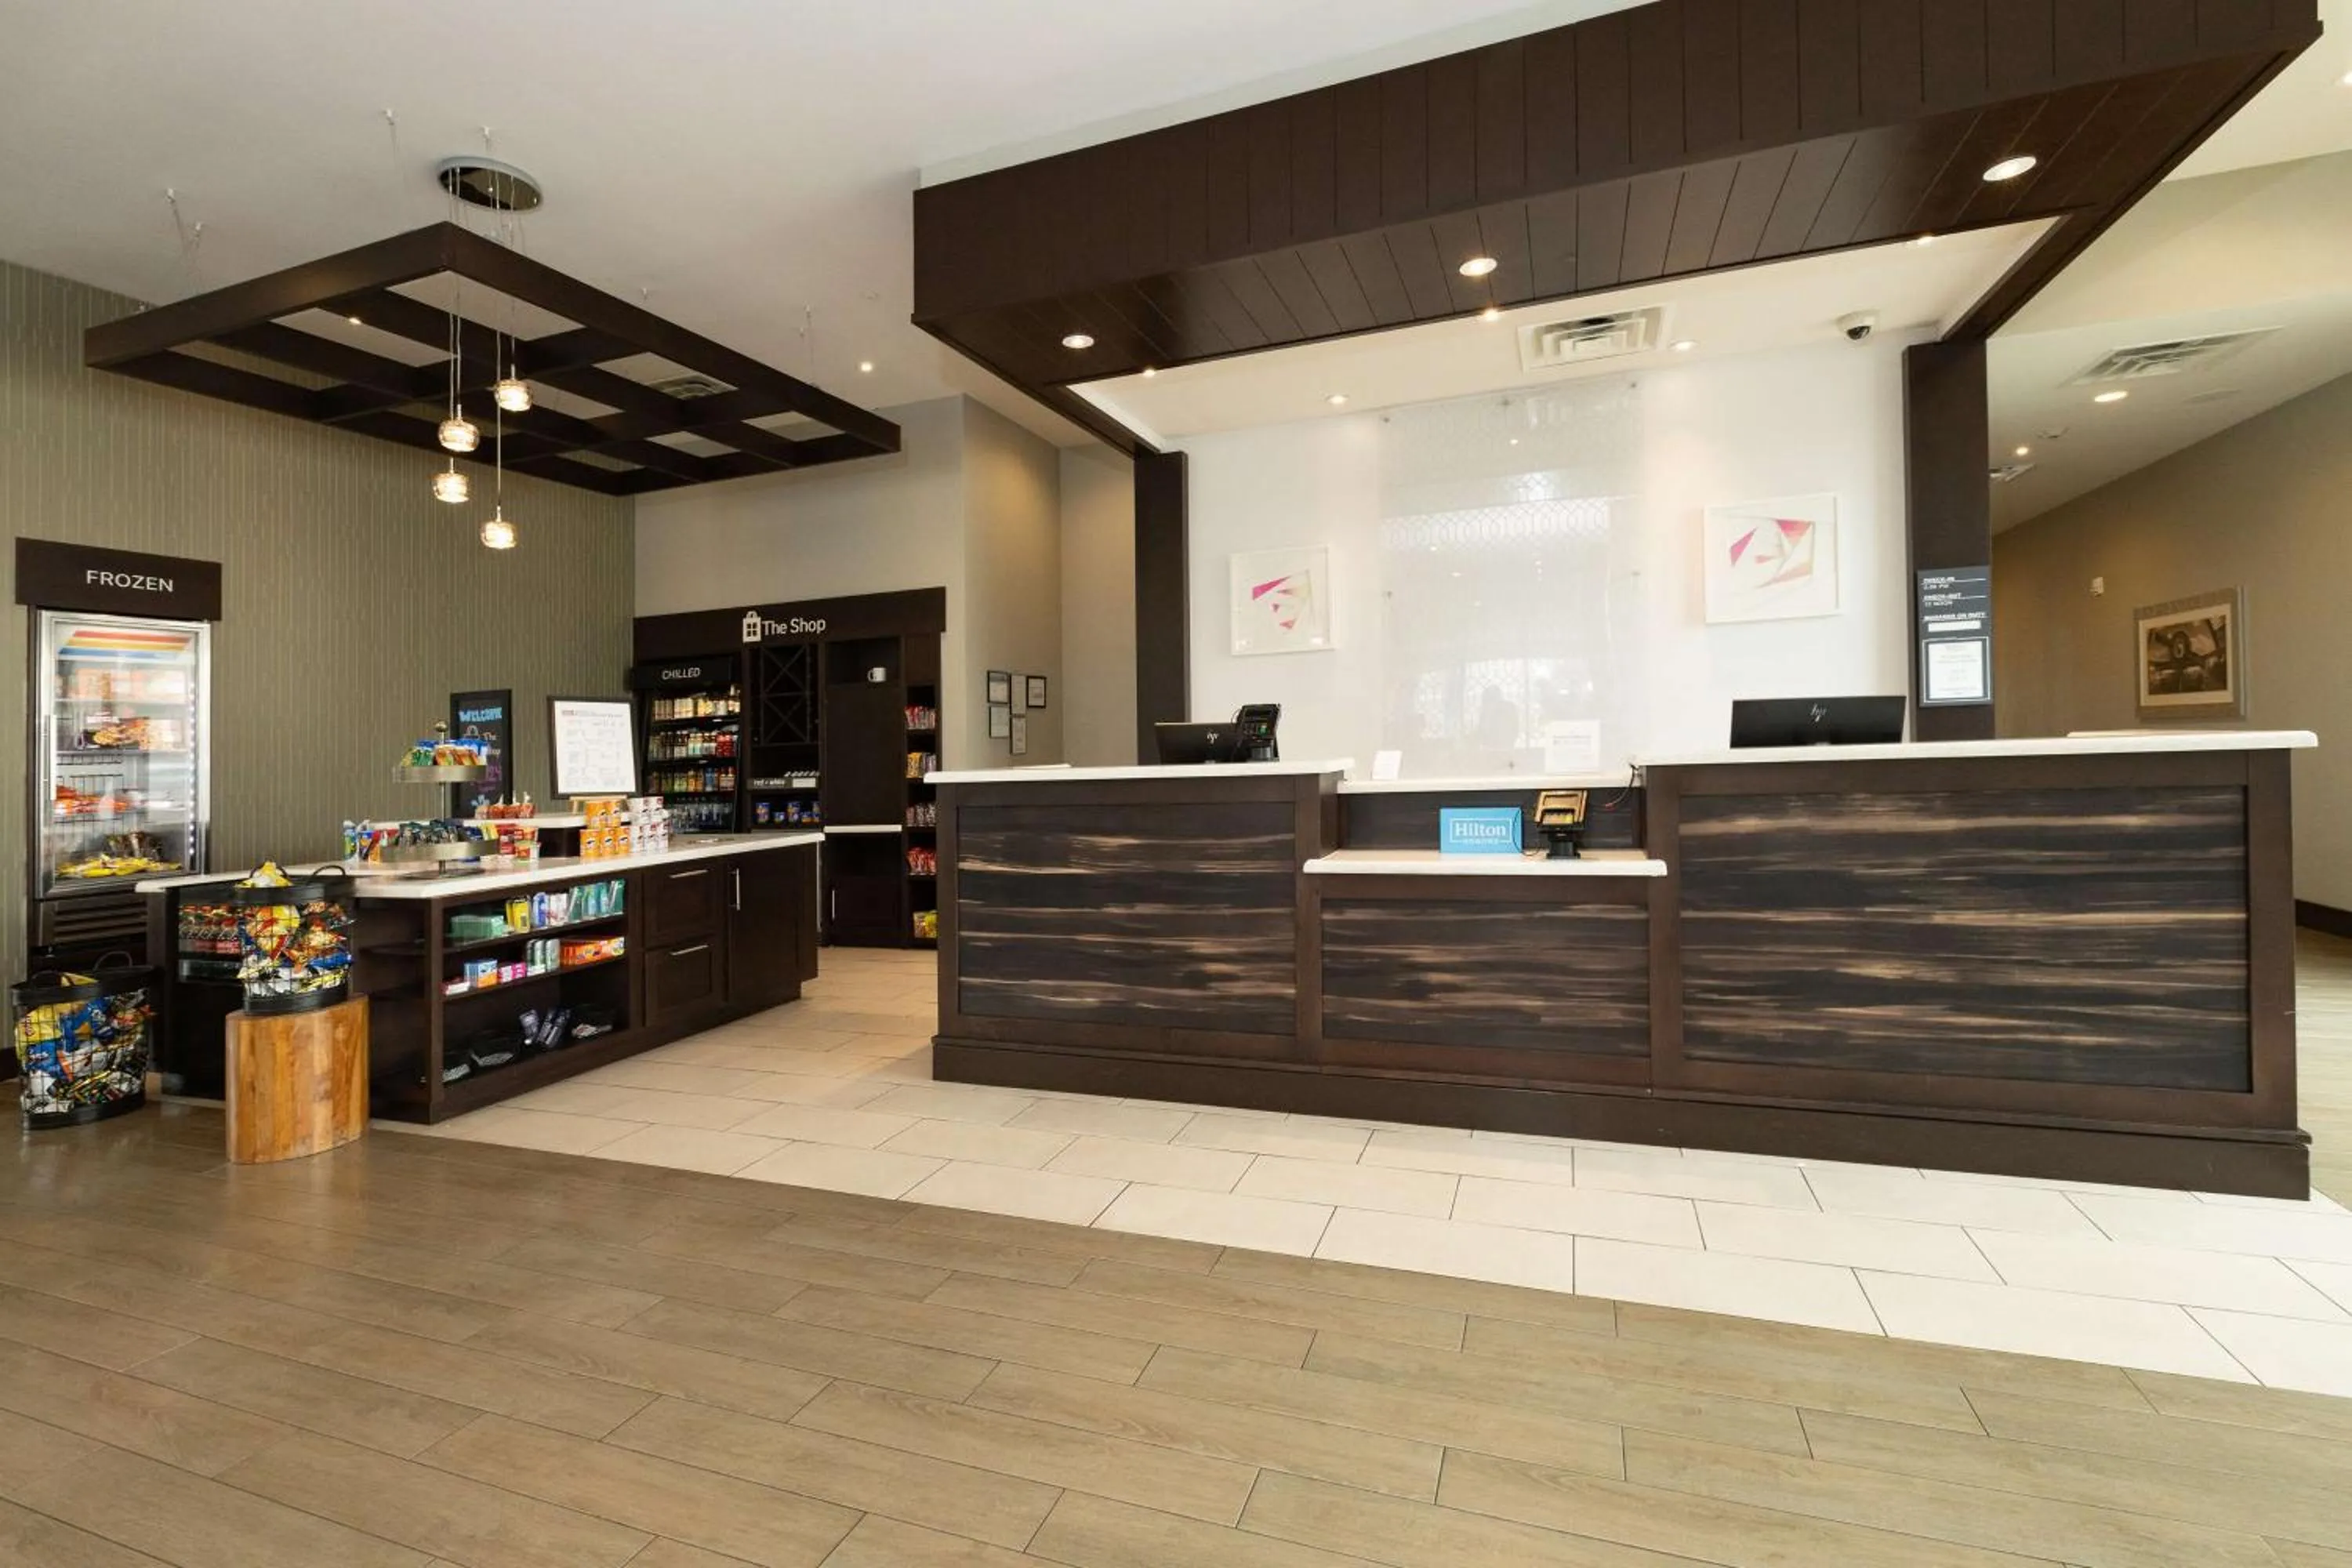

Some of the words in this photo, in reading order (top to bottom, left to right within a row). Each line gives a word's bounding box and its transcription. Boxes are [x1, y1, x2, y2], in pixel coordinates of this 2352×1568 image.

[86, 569, 173, 592] FROZEN
[762, 620, 788, 636] The
[790, 618, 826, 634] Shop
[662, 667, 700, 680] CHILLED
[1456, 822, 1506, 837] Hilton
